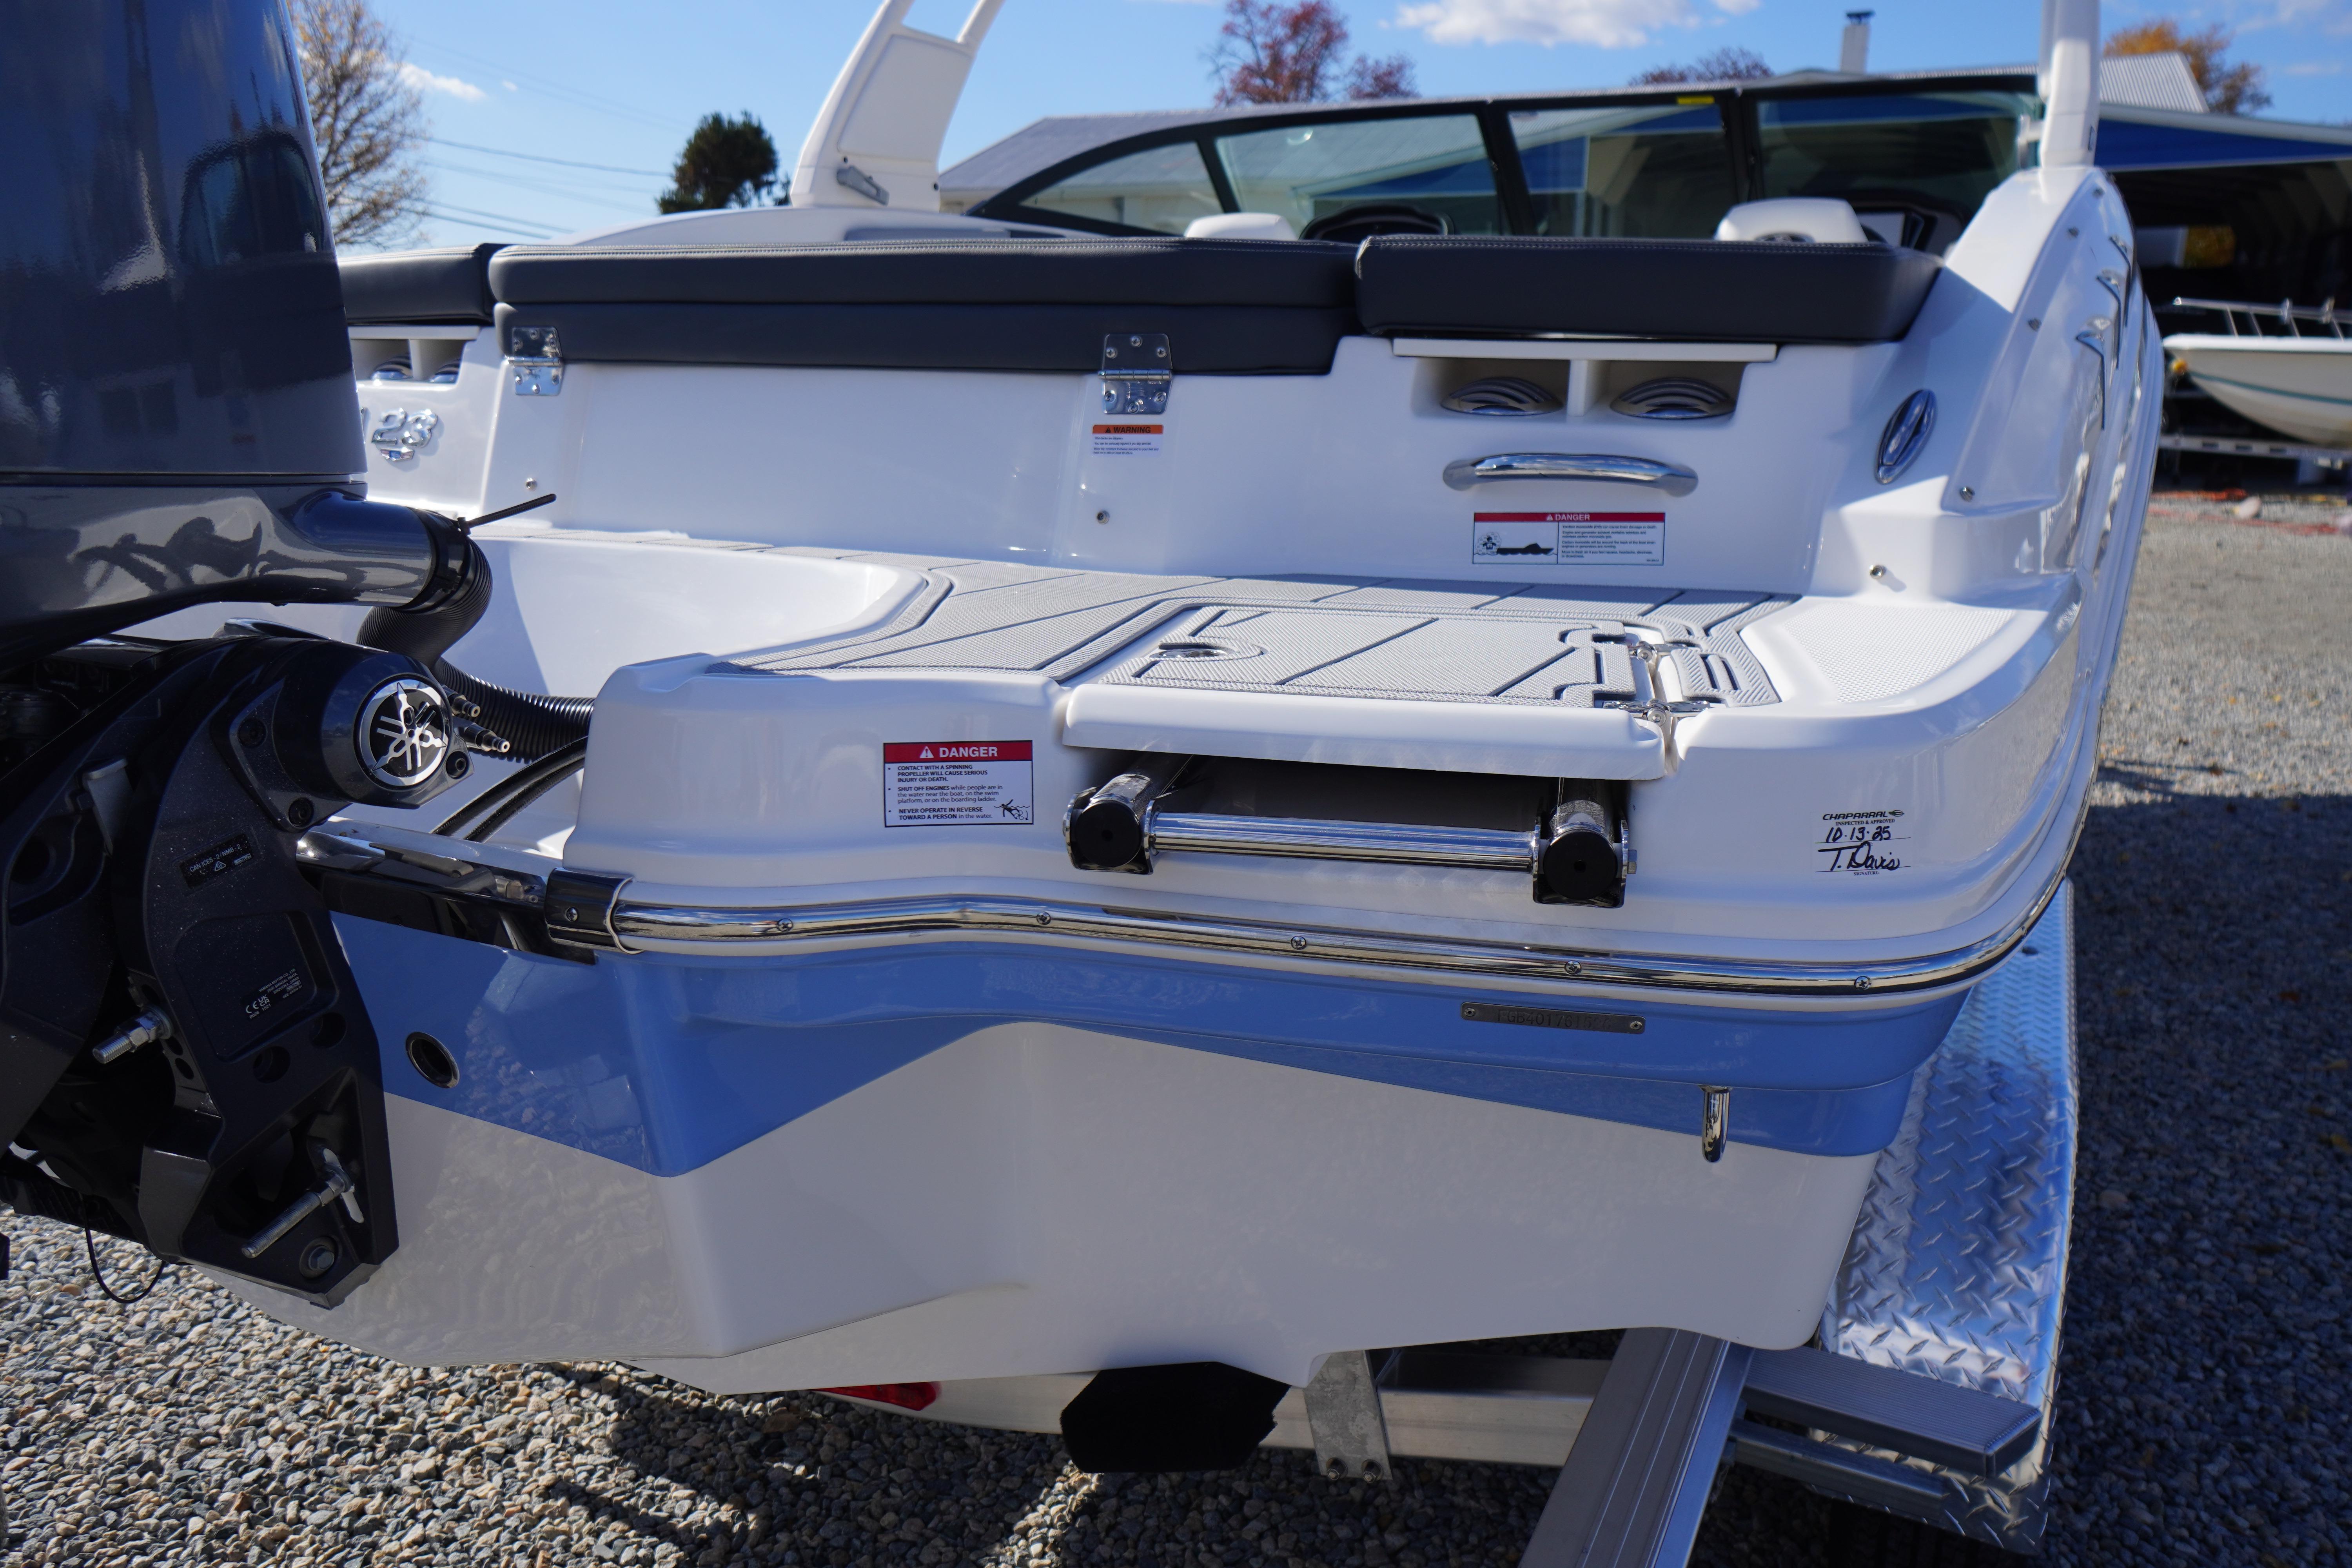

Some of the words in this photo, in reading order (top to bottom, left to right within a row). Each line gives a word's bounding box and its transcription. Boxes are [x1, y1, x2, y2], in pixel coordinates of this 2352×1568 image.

[371, 407, 438, 448] 23
[939, 746, 998, 758] DANGER
[1823, 811, 1888, 820] CHAPARRAL
[190, 863, 201, 873] CAN
[258, 994, 269, 1003] UK
[260, 998, 270, 1007] CA
